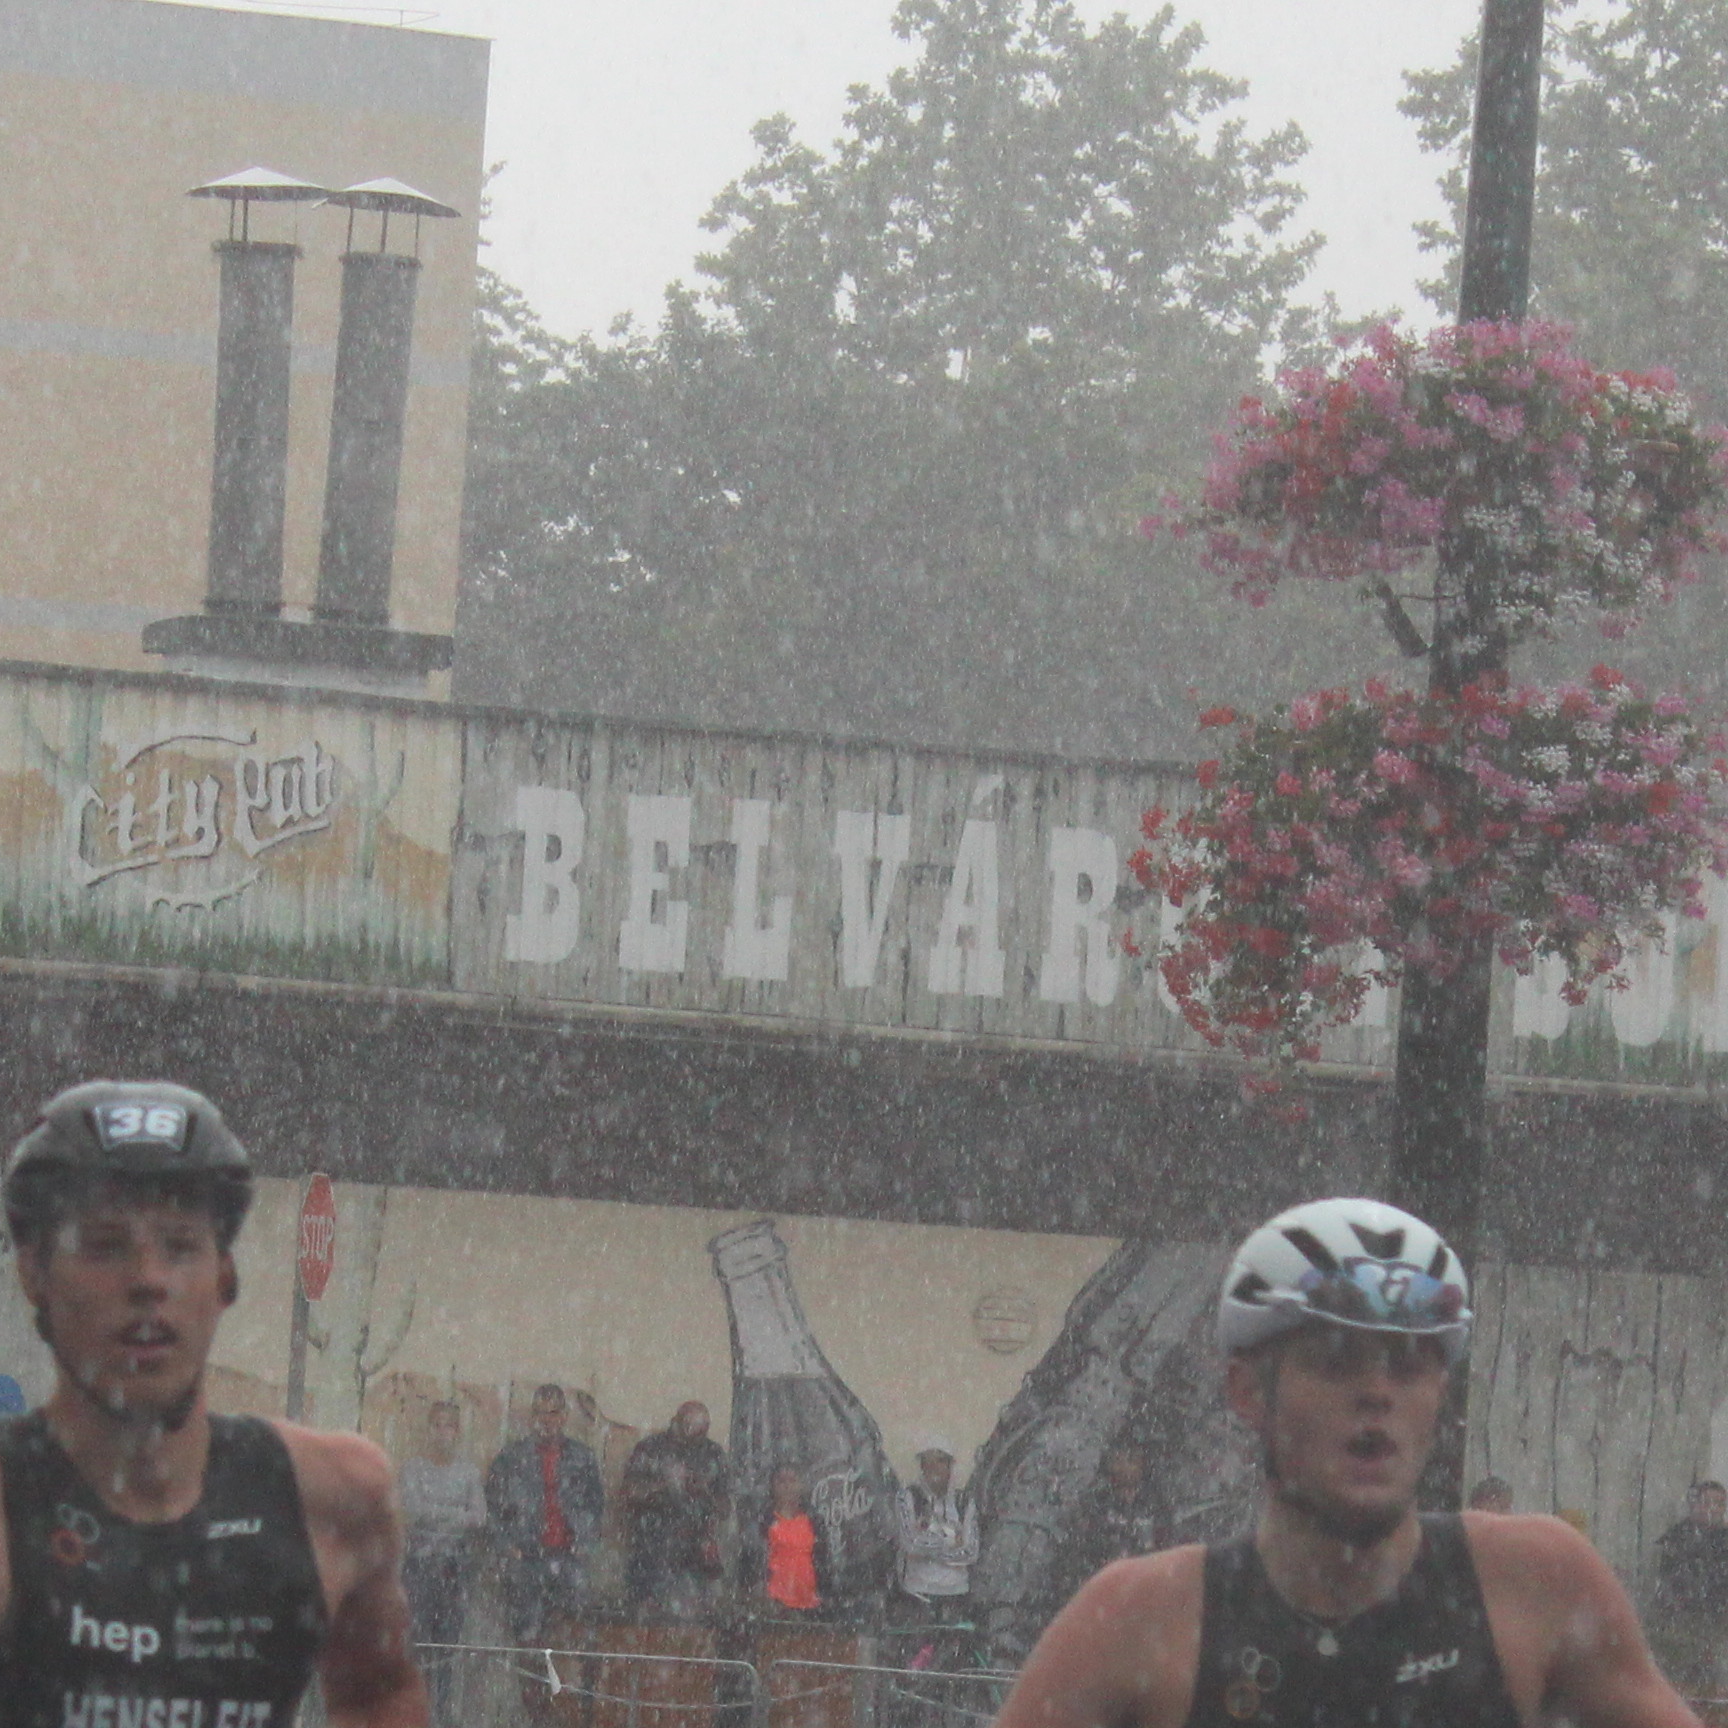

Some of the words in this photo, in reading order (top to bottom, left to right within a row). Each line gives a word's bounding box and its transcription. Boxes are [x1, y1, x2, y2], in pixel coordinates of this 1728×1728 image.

[70, 766, 223, 888] City
[235, 738, 335, 858] Pub
[504, 774, 1389, 1026] BELVÁR
[108, 1107, 182, 1138] 36
[300, 1212, 335, 1263] STOP
[70, 1605, 161, 1663] hep
